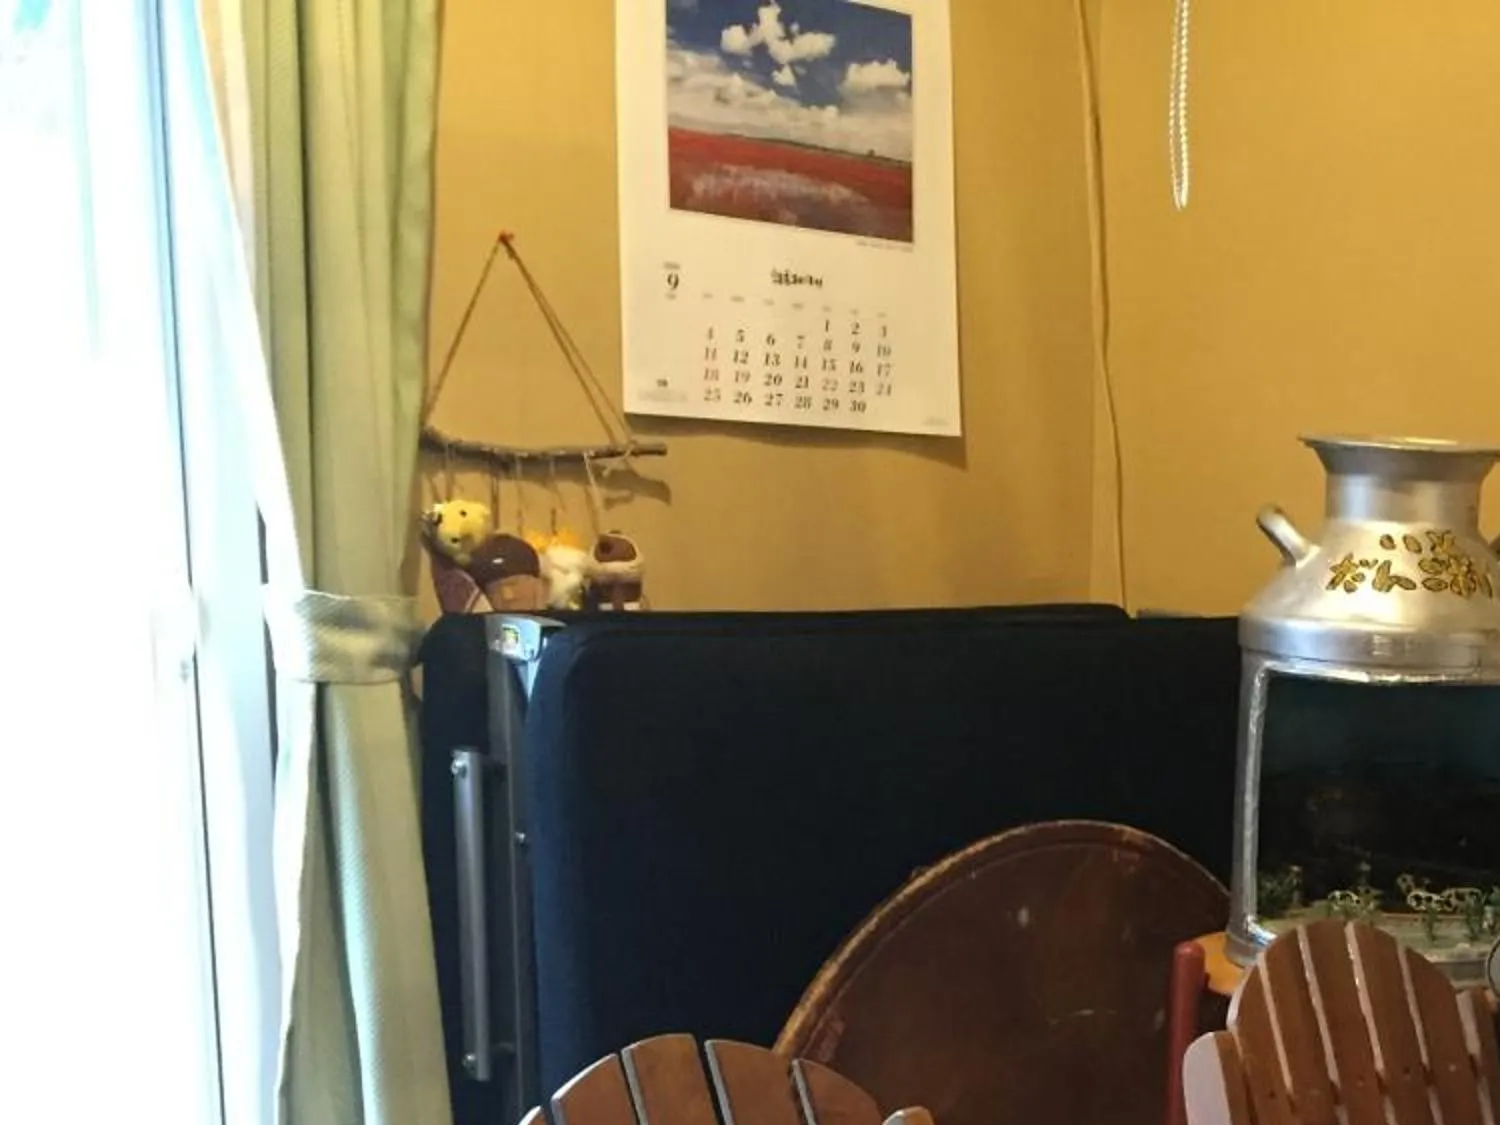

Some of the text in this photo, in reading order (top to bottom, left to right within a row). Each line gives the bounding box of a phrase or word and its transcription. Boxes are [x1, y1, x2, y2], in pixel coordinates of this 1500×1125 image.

[667, 272, 680, 292] 9
[733, 349, 749, 365] 12
[764, 352, 781, 367] 13
[821, 357, 837, 372] 15
[850, 360, 864, 375] 16
[877, 363, 892, 377] 17
[735, 370, 751, 384] 19
[764, 373, 783, 387] 20
[795, 375, 810, 389] 21
[822, 378, 838, 392] 22
[704, 388, 721, 402] 25
[733, 390, 753, 405] 26
[764, 393, 784, 407] 27
[822, 398, 839, 412] 29
[849, 400, 867, 414] 30
